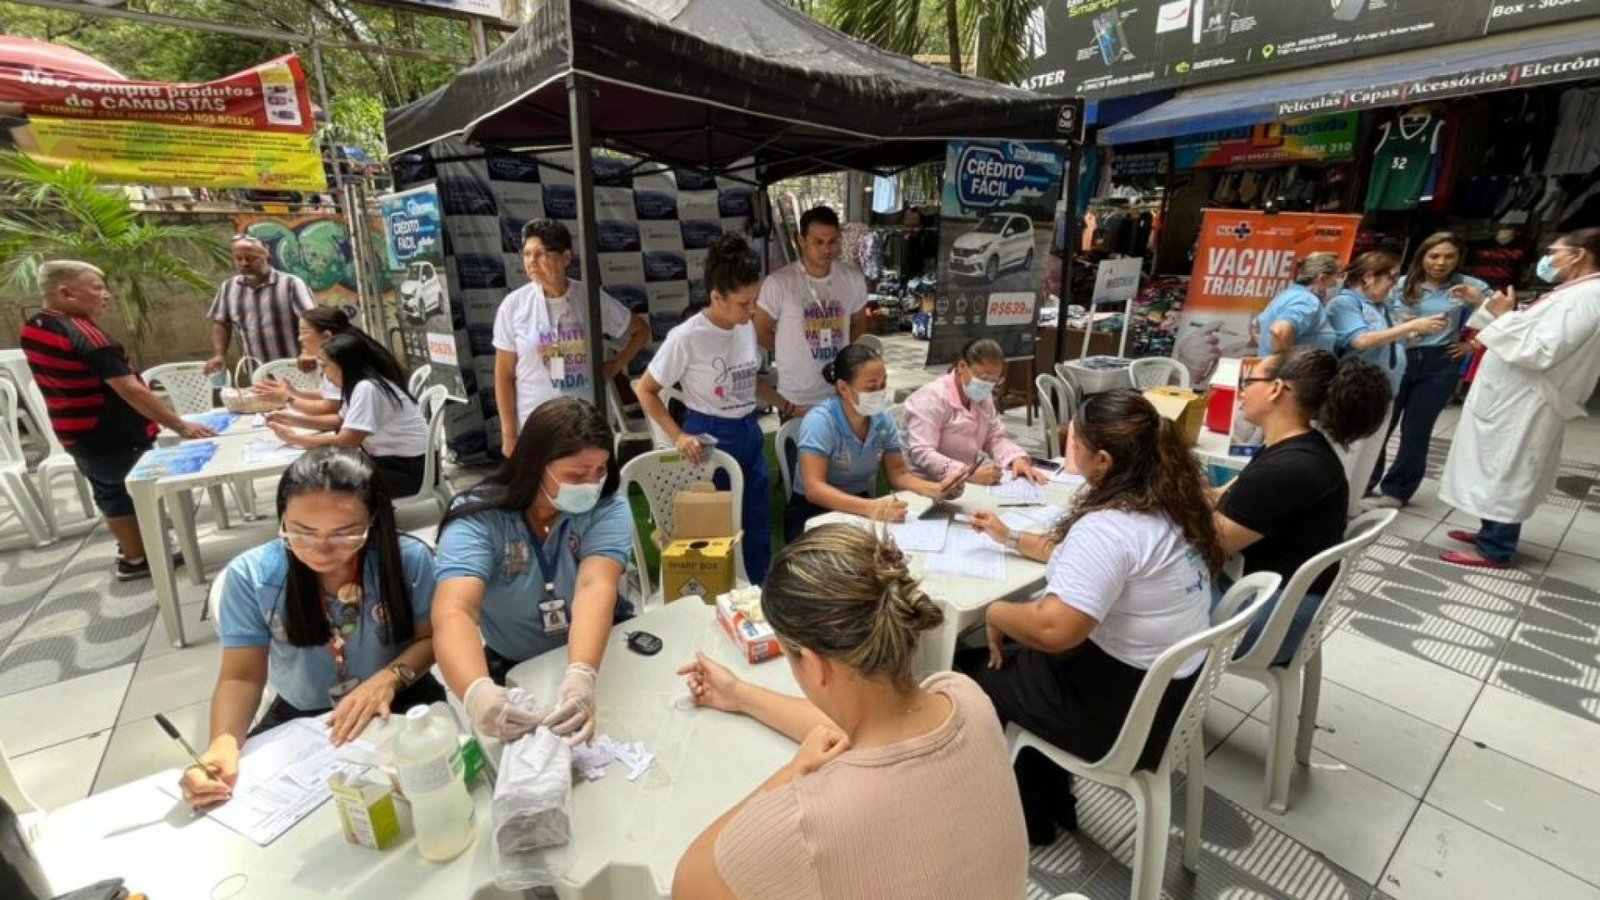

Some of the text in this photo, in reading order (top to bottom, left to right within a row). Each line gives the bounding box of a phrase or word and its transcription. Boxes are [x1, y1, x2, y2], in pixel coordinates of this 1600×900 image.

[1492, 3, 1524, 18] Box
[75, 82, 160, 98] compre
[167, 85, 255, 99] produtos
[1351, 86, 1399, 105] Capas
[1409, 71, 1508, 96] Acessórios
[65, 93, 226, 112] de CAMBISTAS
[966, 157, 1025, 180] CRÉDITO
[971, 176, 1009, 197] FÁCIL
[1207, 247, 1296, 278] VACINE
[991, 300, 1032, 317] R$639
[699, 560, 719, 570] BOX
